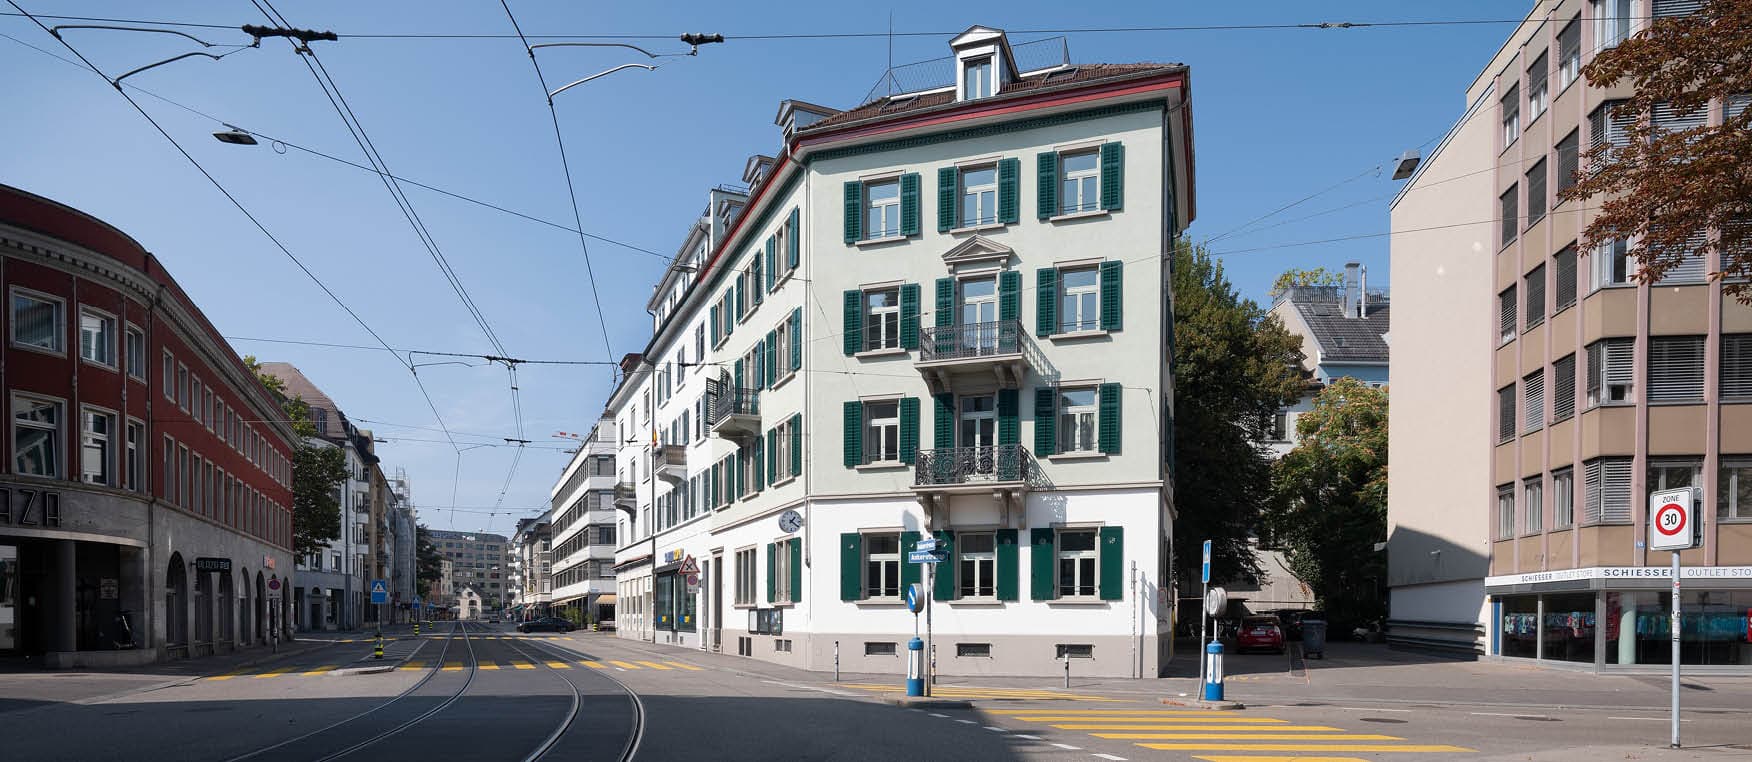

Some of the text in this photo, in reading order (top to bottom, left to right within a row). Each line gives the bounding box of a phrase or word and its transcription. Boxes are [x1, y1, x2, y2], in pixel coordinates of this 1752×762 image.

[1662, 494, 1680, 503] ZONE
[1664, 513, 1677, 526] 30
[1687, 568, 1728, 577] OUTLET
[1521, 573, 1552, 582] SCHIESSER
